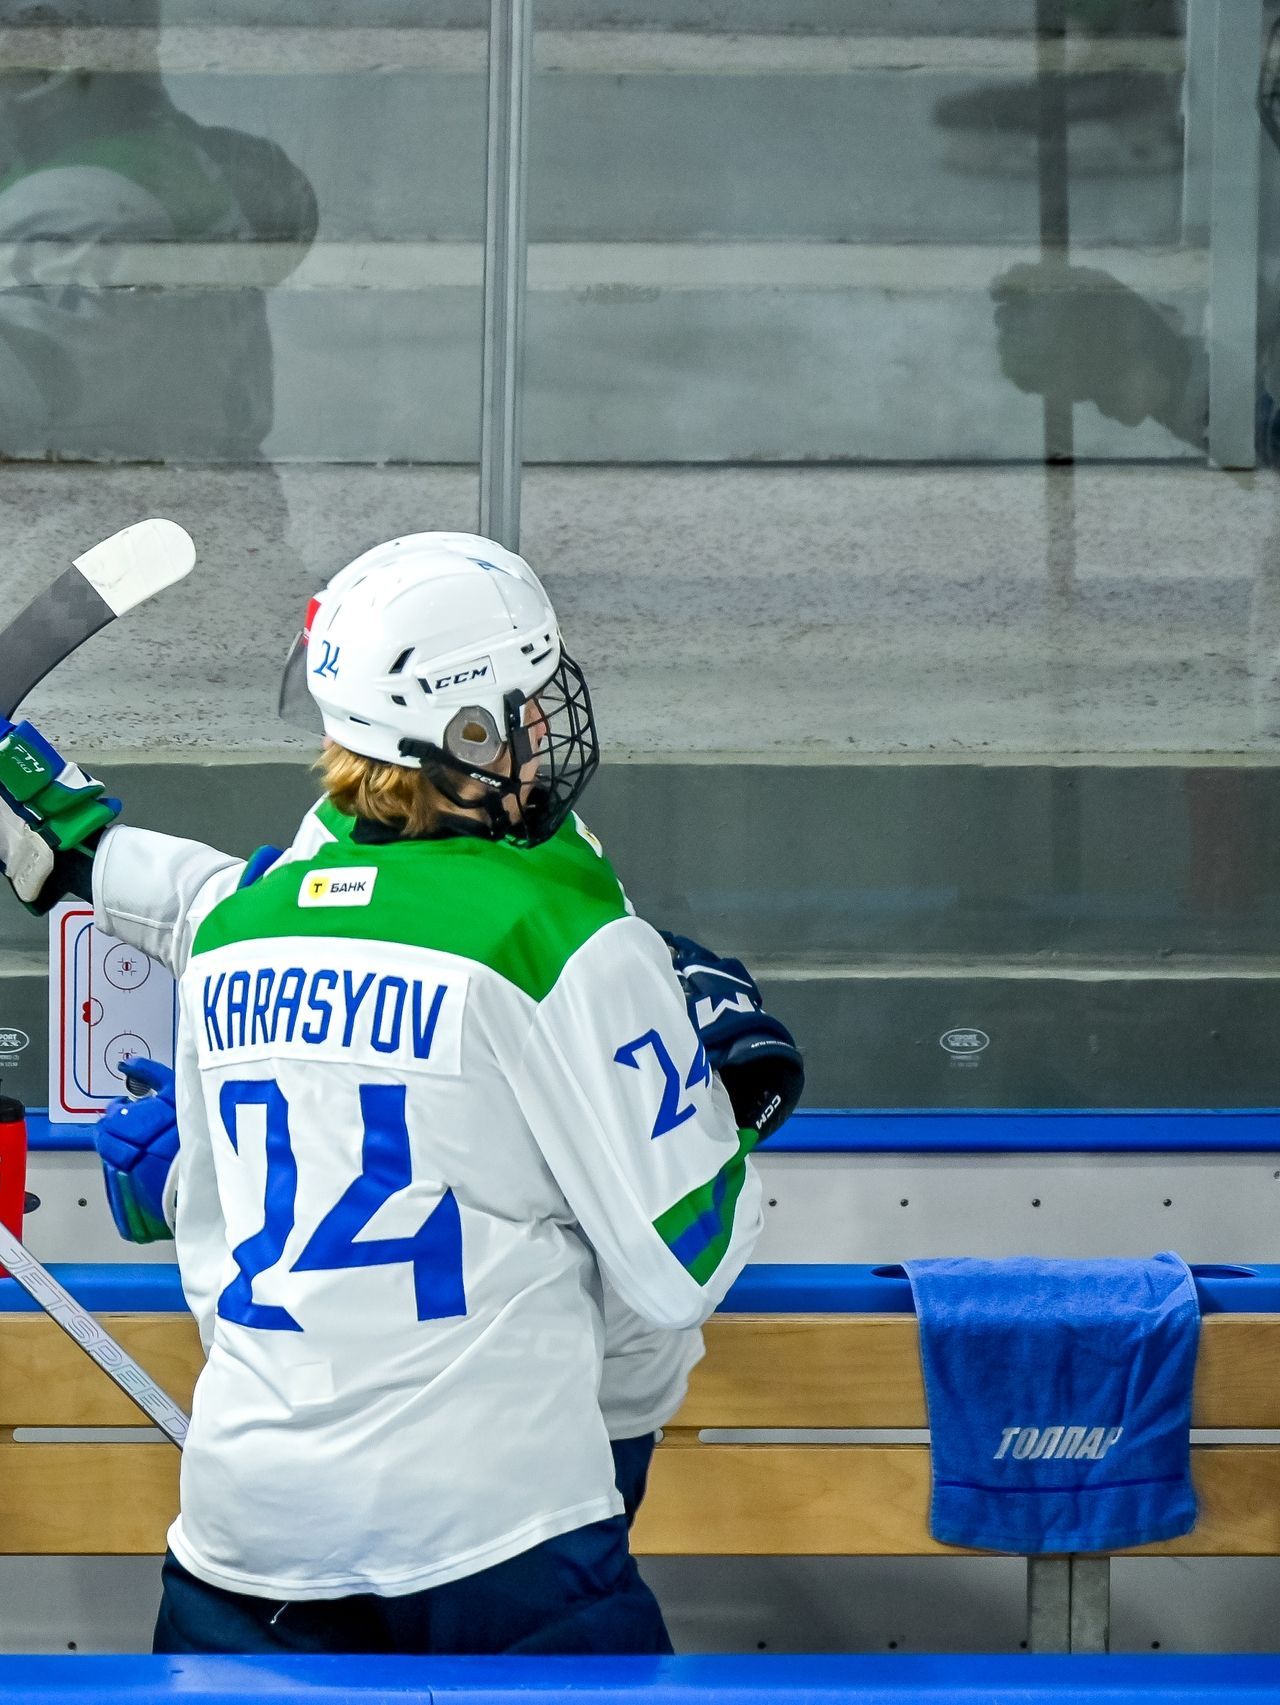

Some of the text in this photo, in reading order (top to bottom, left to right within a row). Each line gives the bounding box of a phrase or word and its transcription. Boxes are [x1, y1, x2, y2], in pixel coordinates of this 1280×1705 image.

[313, 640, 340, 680] 24
[435, 666, 488, 689] CCM
[470, 772, 502, 788] CCM
[330, 881, 366, 893] БАНК
[204, 966, 448, 1060] KARASYOV
[755, 1094, 782, 1130] CCM
[217, 1078, 468, 1332] 24
[993, 1426, 1124, 1460] ТОЛПАР
